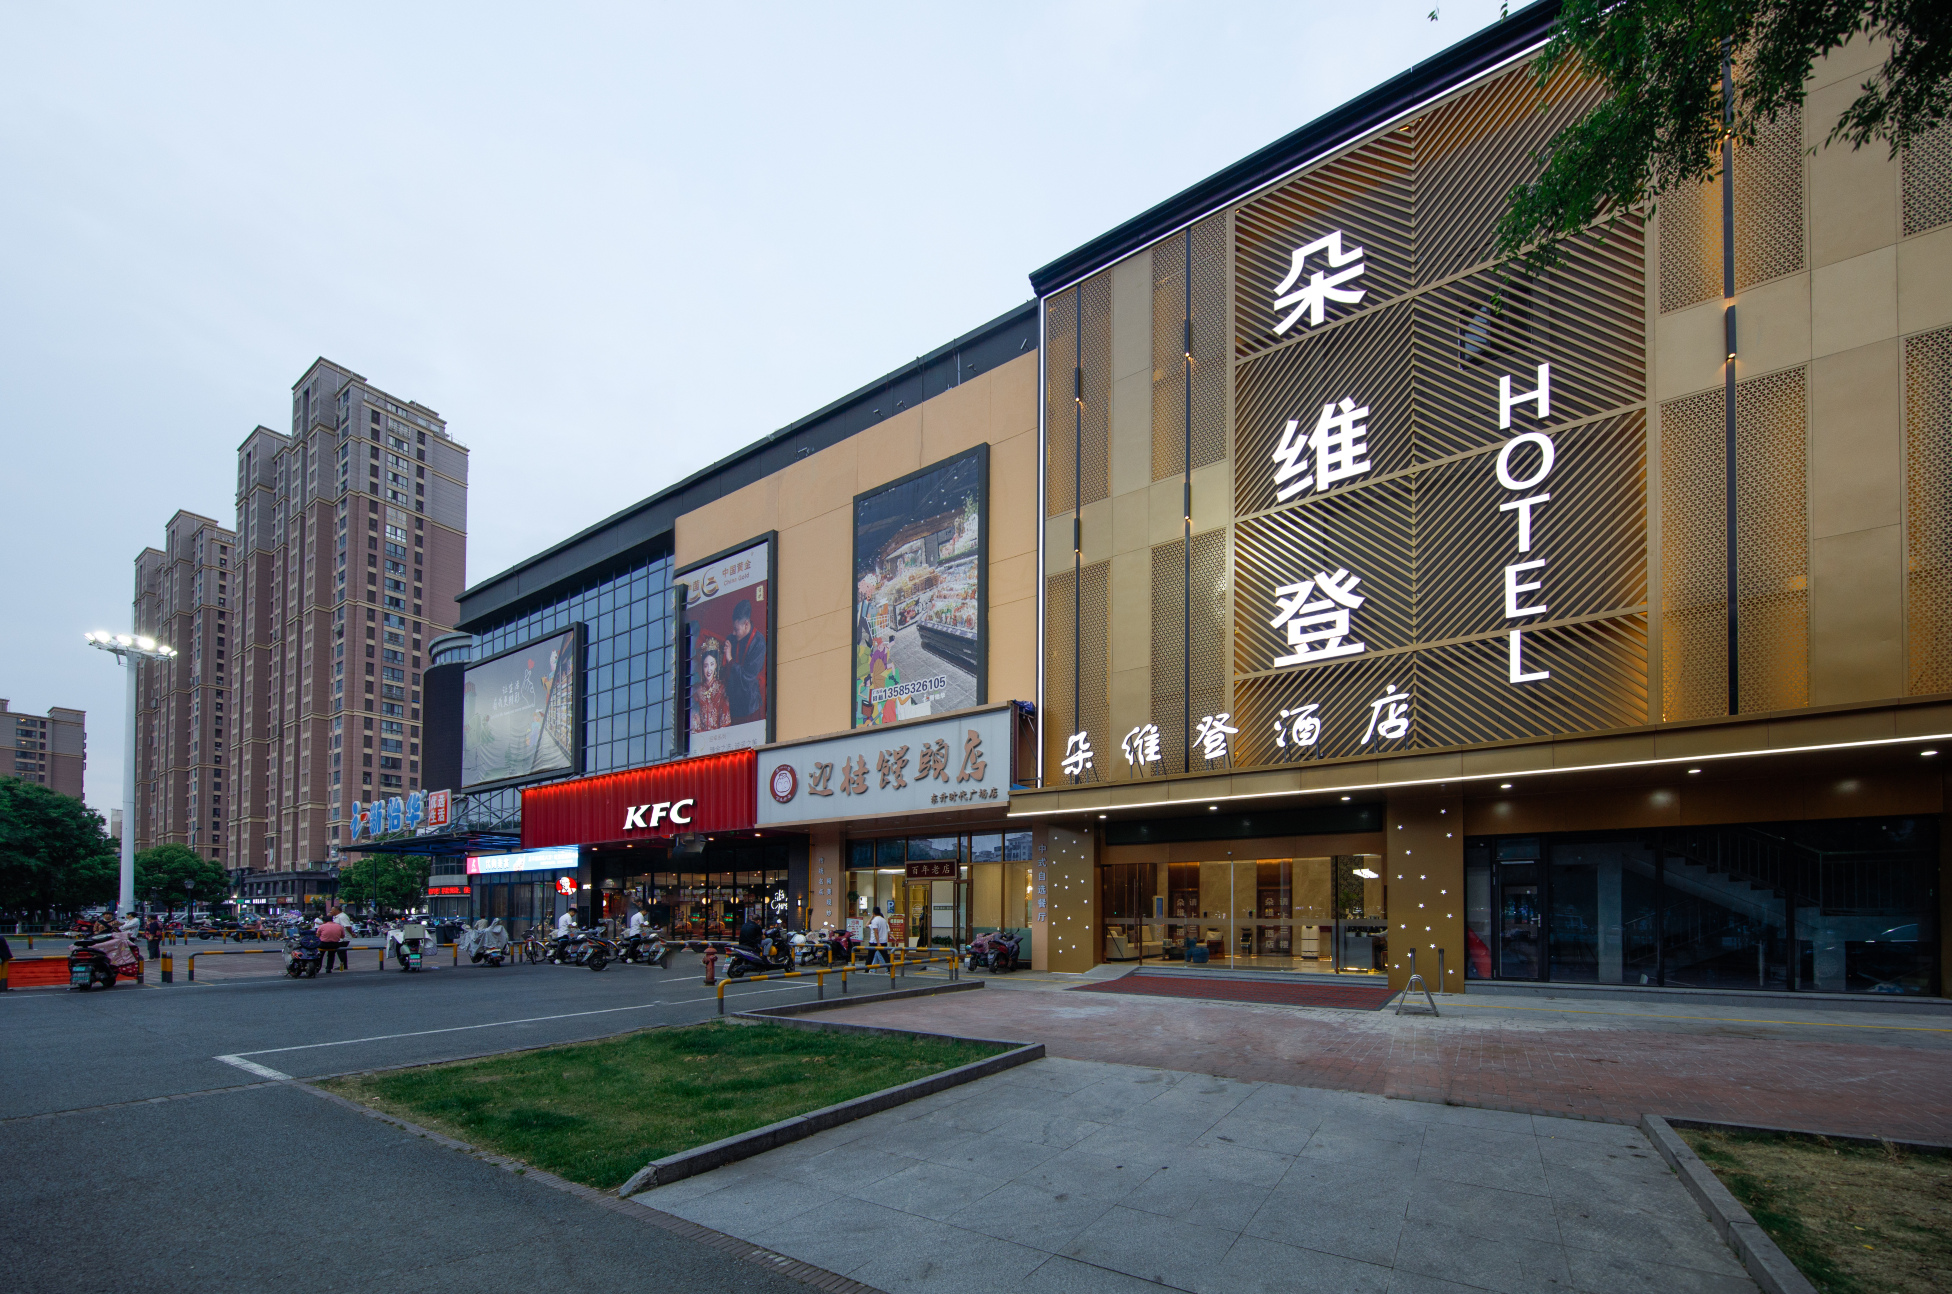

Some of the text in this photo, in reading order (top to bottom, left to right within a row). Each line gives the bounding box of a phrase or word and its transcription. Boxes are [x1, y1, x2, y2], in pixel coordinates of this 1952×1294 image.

[1272, 230, 1371, 669] 朵维登
[1495, 362, 1555, 684] HOTEL
[738, 572, 750, 581] Gold
[883, 676, 946, 699] 13585326105
[1061, 684, 1410, 775] 朵维登酒店
[622, 798, 694, 829] KFC
[912, 864, 950, 875] 百年老店
[1037, 844, 1047, 922] 中式自选餐厅
[1177, 898, 1185, 948] 朵维酒店
[1265, 898, 1274, 948] 朵维酒店
